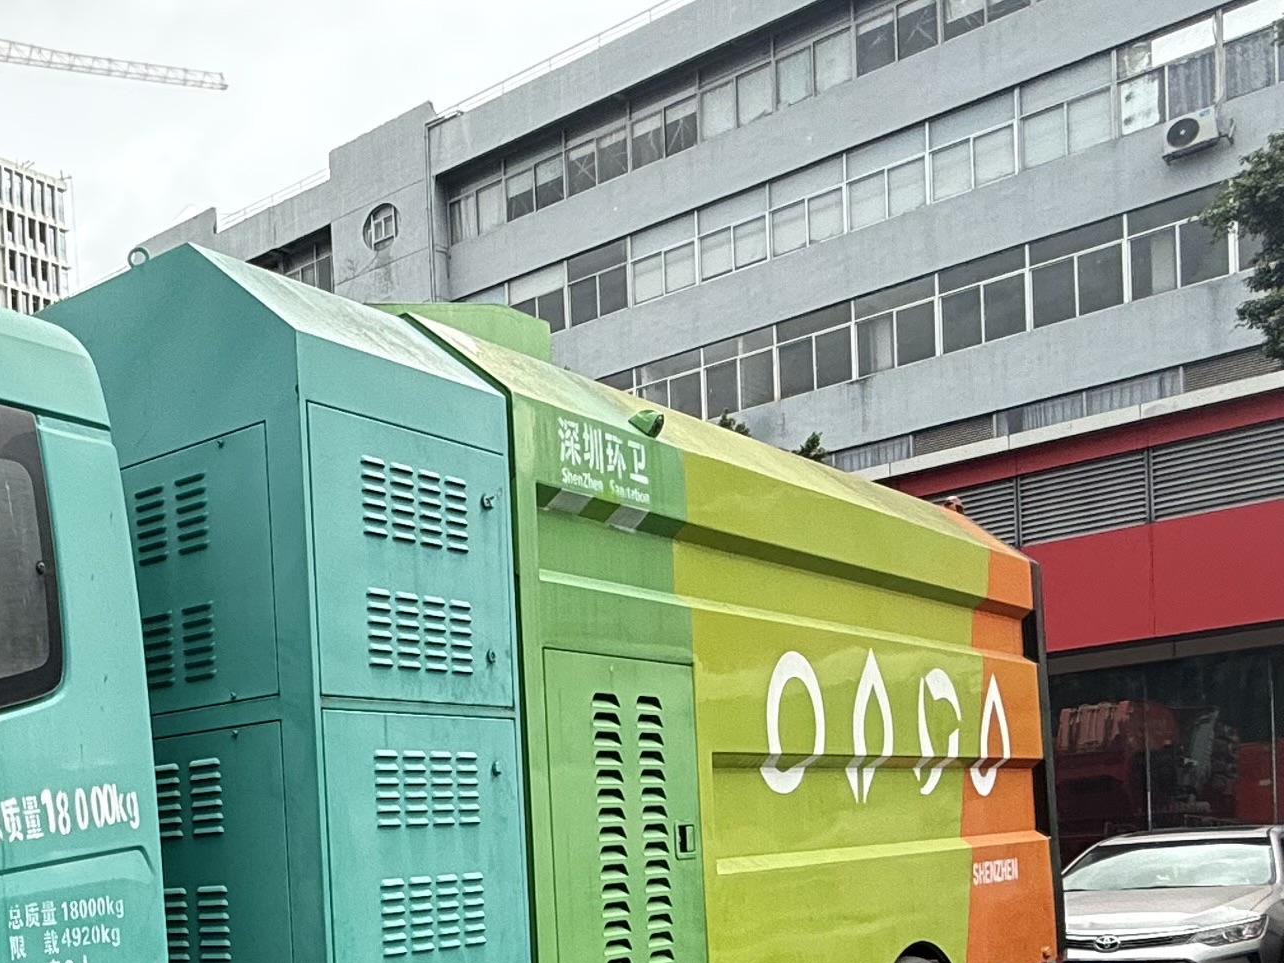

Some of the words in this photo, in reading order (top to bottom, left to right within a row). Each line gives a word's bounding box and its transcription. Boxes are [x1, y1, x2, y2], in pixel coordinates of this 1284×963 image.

[558, 417, 649, 484] 深圳环卫
[972, 857, 1019, 886] SHENZHEN
